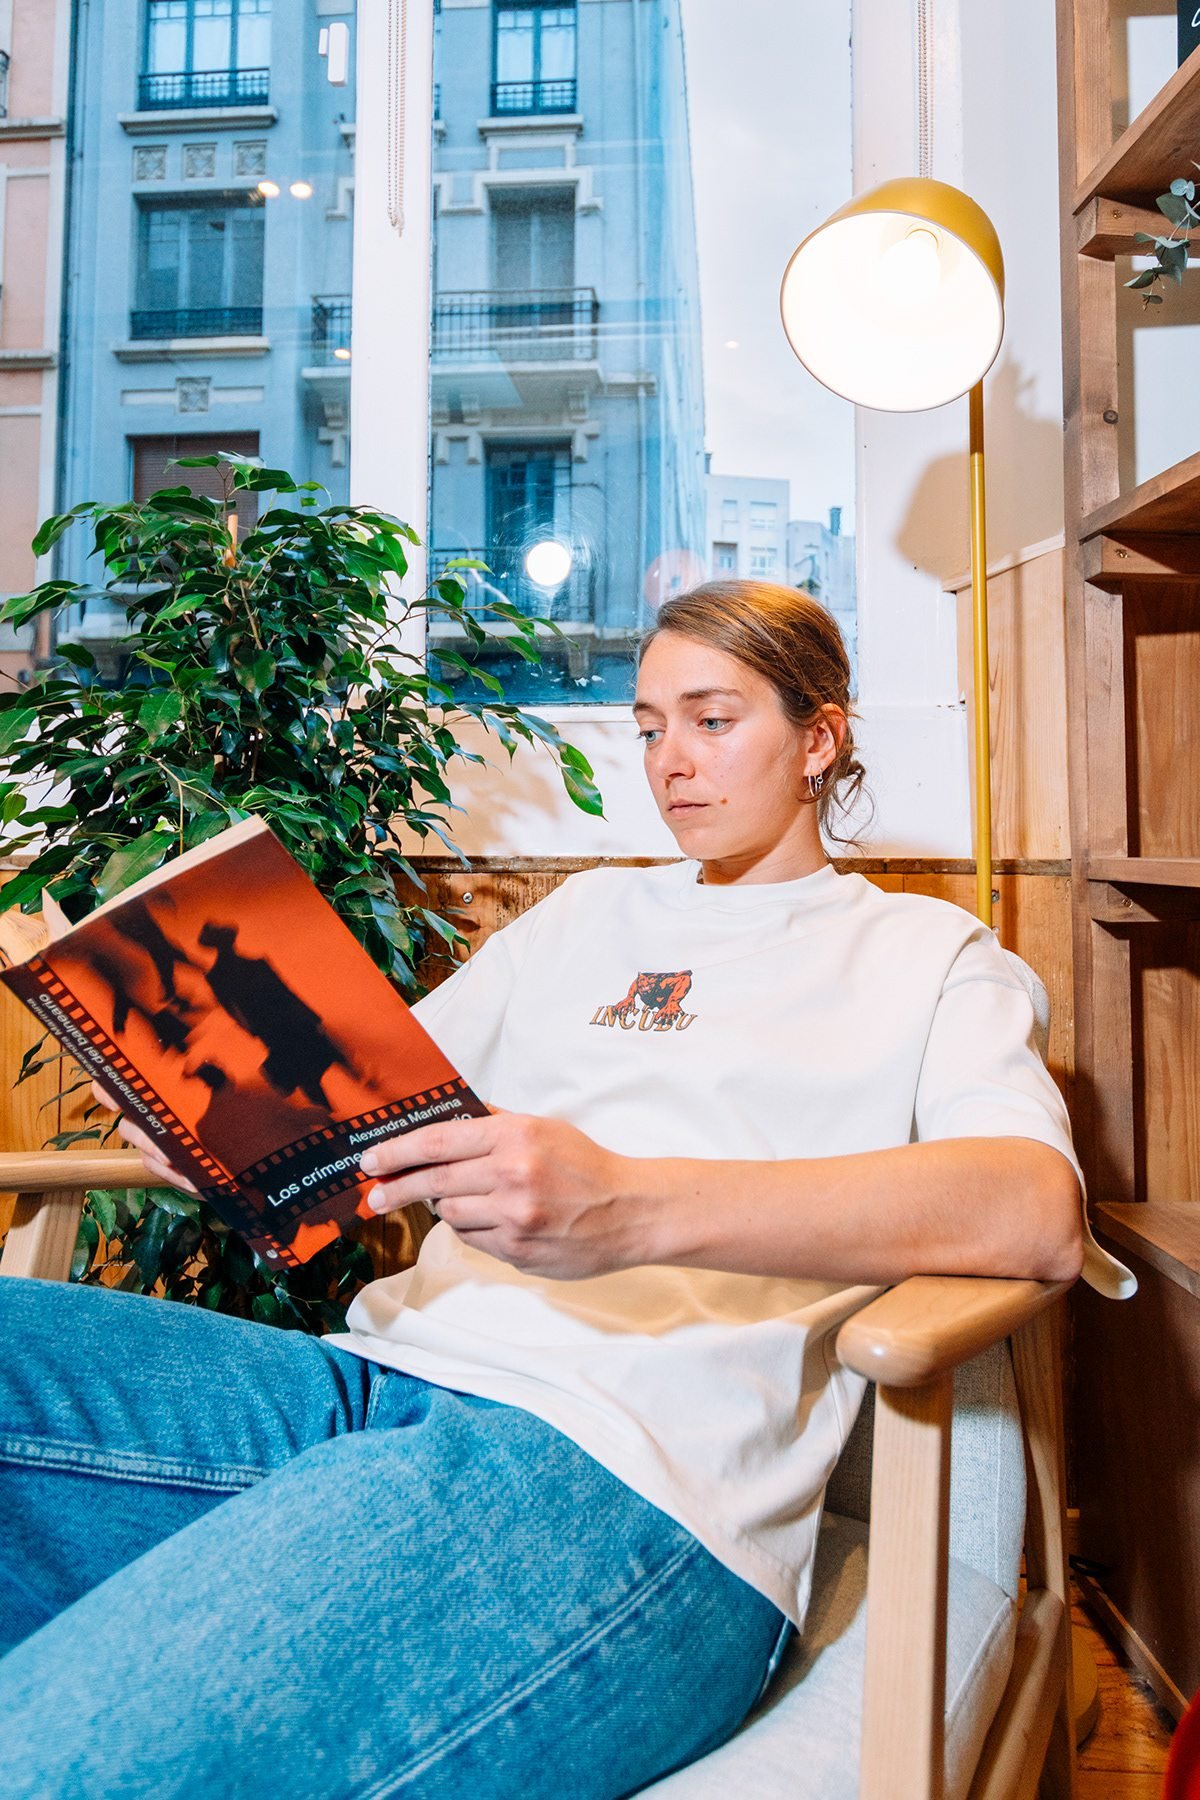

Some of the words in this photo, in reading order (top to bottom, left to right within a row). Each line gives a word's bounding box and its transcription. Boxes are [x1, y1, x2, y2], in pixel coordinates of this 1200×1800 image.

[39, 993, 88, 1046] balneario
[60, 1036, 101, 1077] Alexandra
[83, 1046, 104, 1064] del
[102, 1064, 149, 1114] crímenes
[145, 1113, 168, 1135] Los
[349, 1120, 408, 1145] Alexandra
[407, 1098, 462, 1123] Marínina
[267, 1183, 301, 1207] Los
[301, 1152, 363, 1187] crímene
